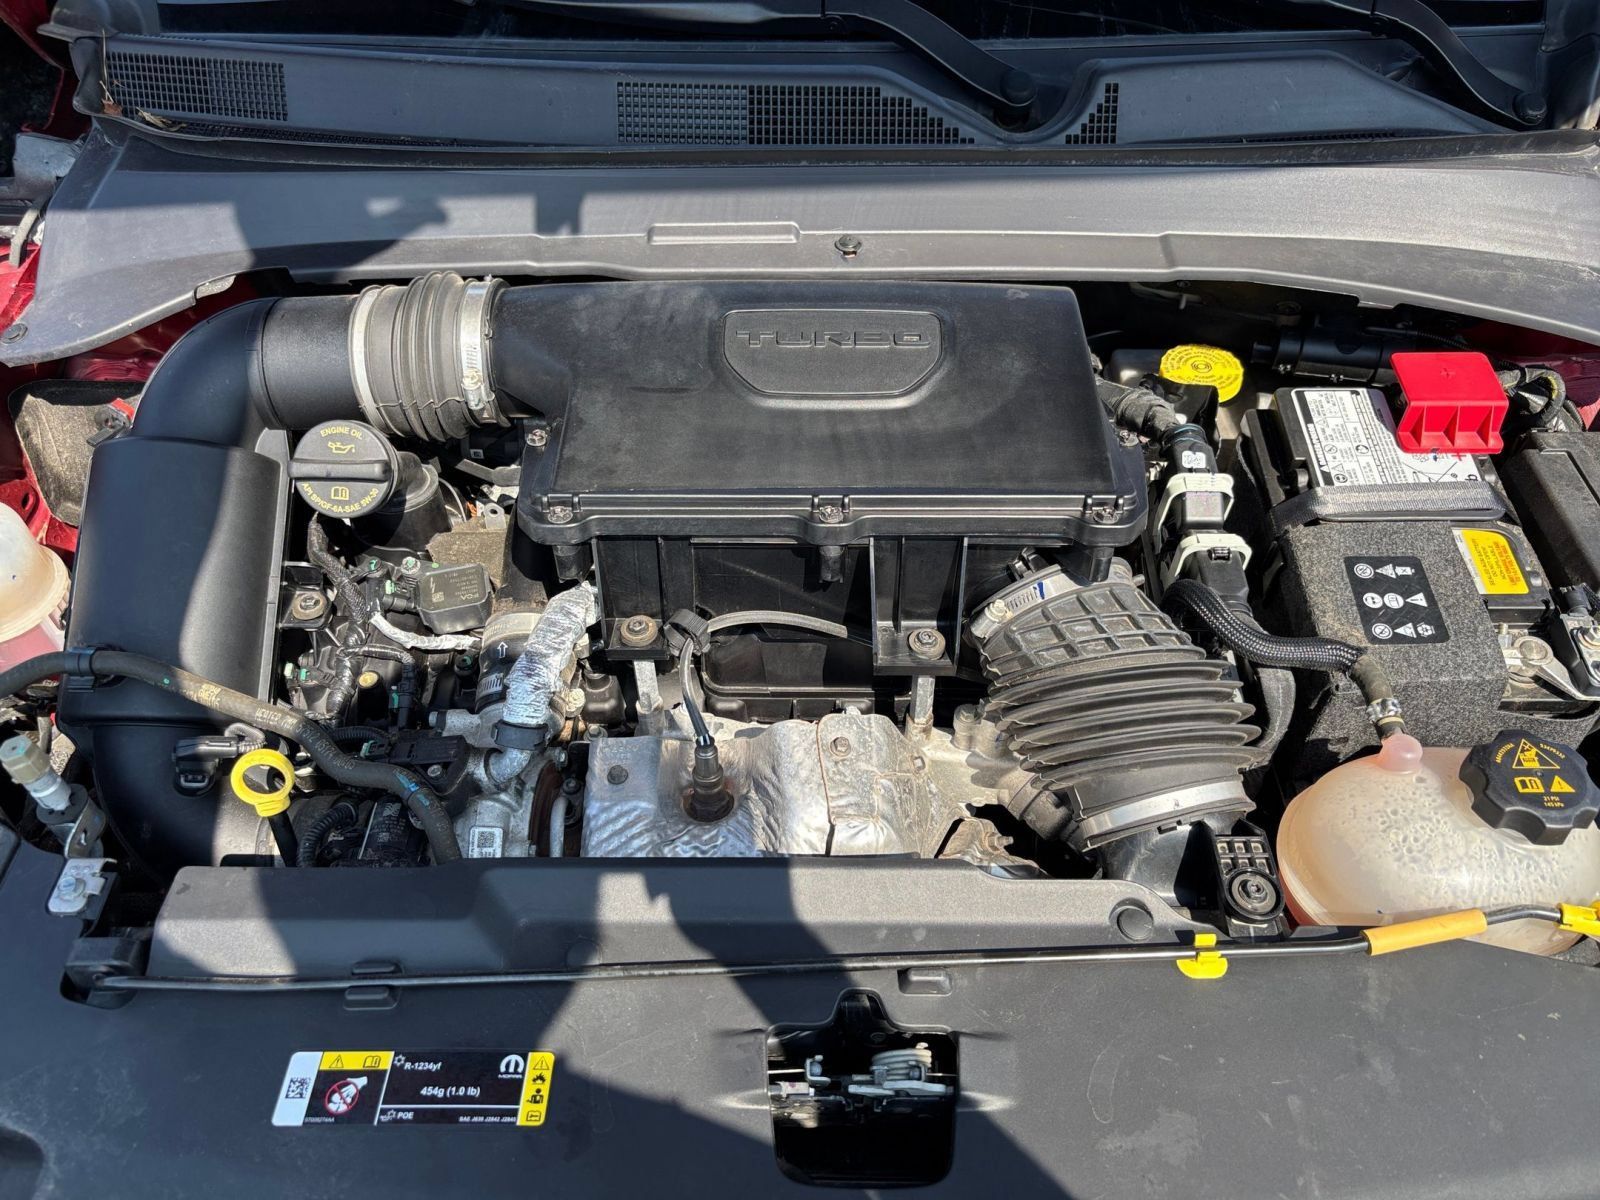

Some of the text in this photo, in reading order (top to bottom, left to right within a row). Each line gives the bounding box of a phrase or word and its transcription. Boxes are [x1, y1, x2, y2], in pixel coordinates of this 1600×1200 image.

[736, 331, 931, 348] TURBO
[320, 426, 364, 440] ENGINE OIL
[301, 482, 312, 496] API
[404, 1061, 442, 1072] R-1234yf
[420, 1086, 481, 1098] 454g (1.0 lb)
[397, 1111, 414, 1120] POE
